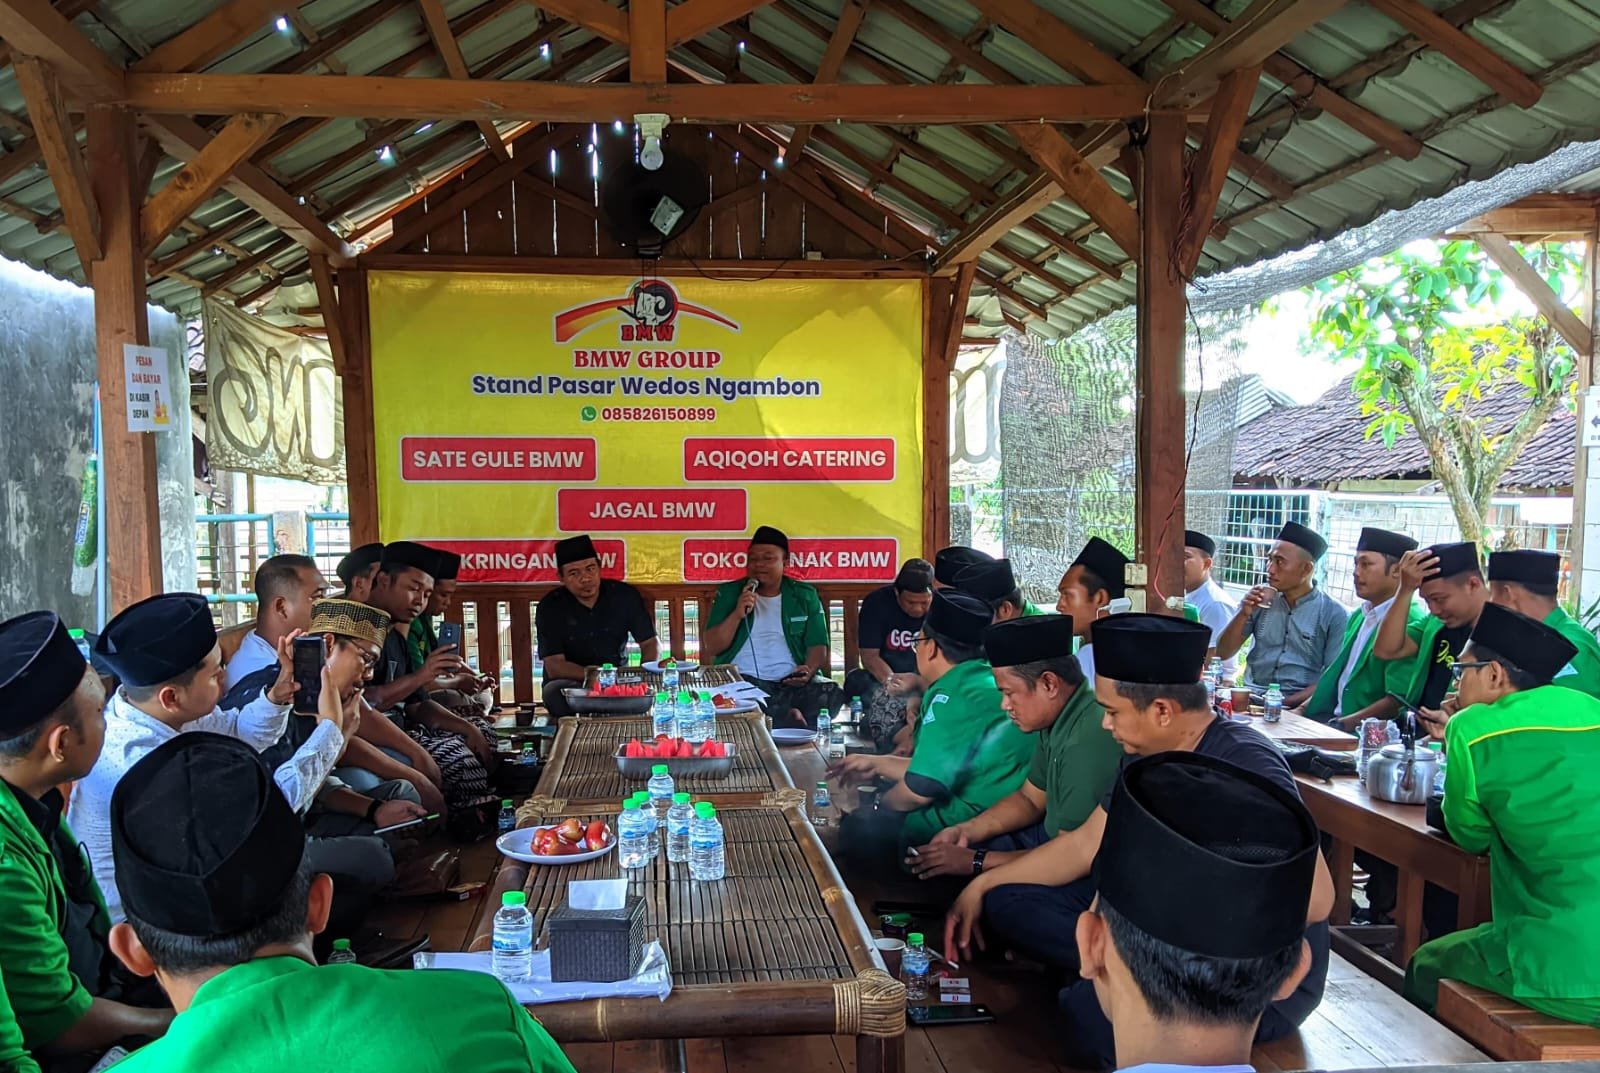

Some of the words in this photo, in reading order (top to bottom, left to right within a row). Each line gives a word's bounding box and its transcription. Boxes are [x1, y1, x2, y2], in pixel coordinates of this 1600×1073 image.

[621, 325, 675, 342] BMW
[135, 356, 153, 367] PESAN
[573, 351, 632, 368] BMW
[637, 351, 722, 369] GROUP
[472, 376, 542, 395] Stand
[548, 376, 616, 395] Pasar
[621, 377, 700, 396] Wedos
[705, 377, 820, 401] Ngambon
[601, 407, 716, 421] 085826150899
[413, 451, 467, 468] SATE
[471, 451, 524, 468] GULE
[529, 452, 584, 468] BMW
[693, 450, 778, 469] AQIQOH
[782, 450, 887, 467] CATERING
[589, 502, 658, 518] JAGAL
[662, 502, 716, 518] BMW
[460, 553, 557, 569] KRINGAN
[690, 552, 747, 569] TOKO
[789, 551, 833, 568] NAK
[837, 551, 890, 568] BMW
